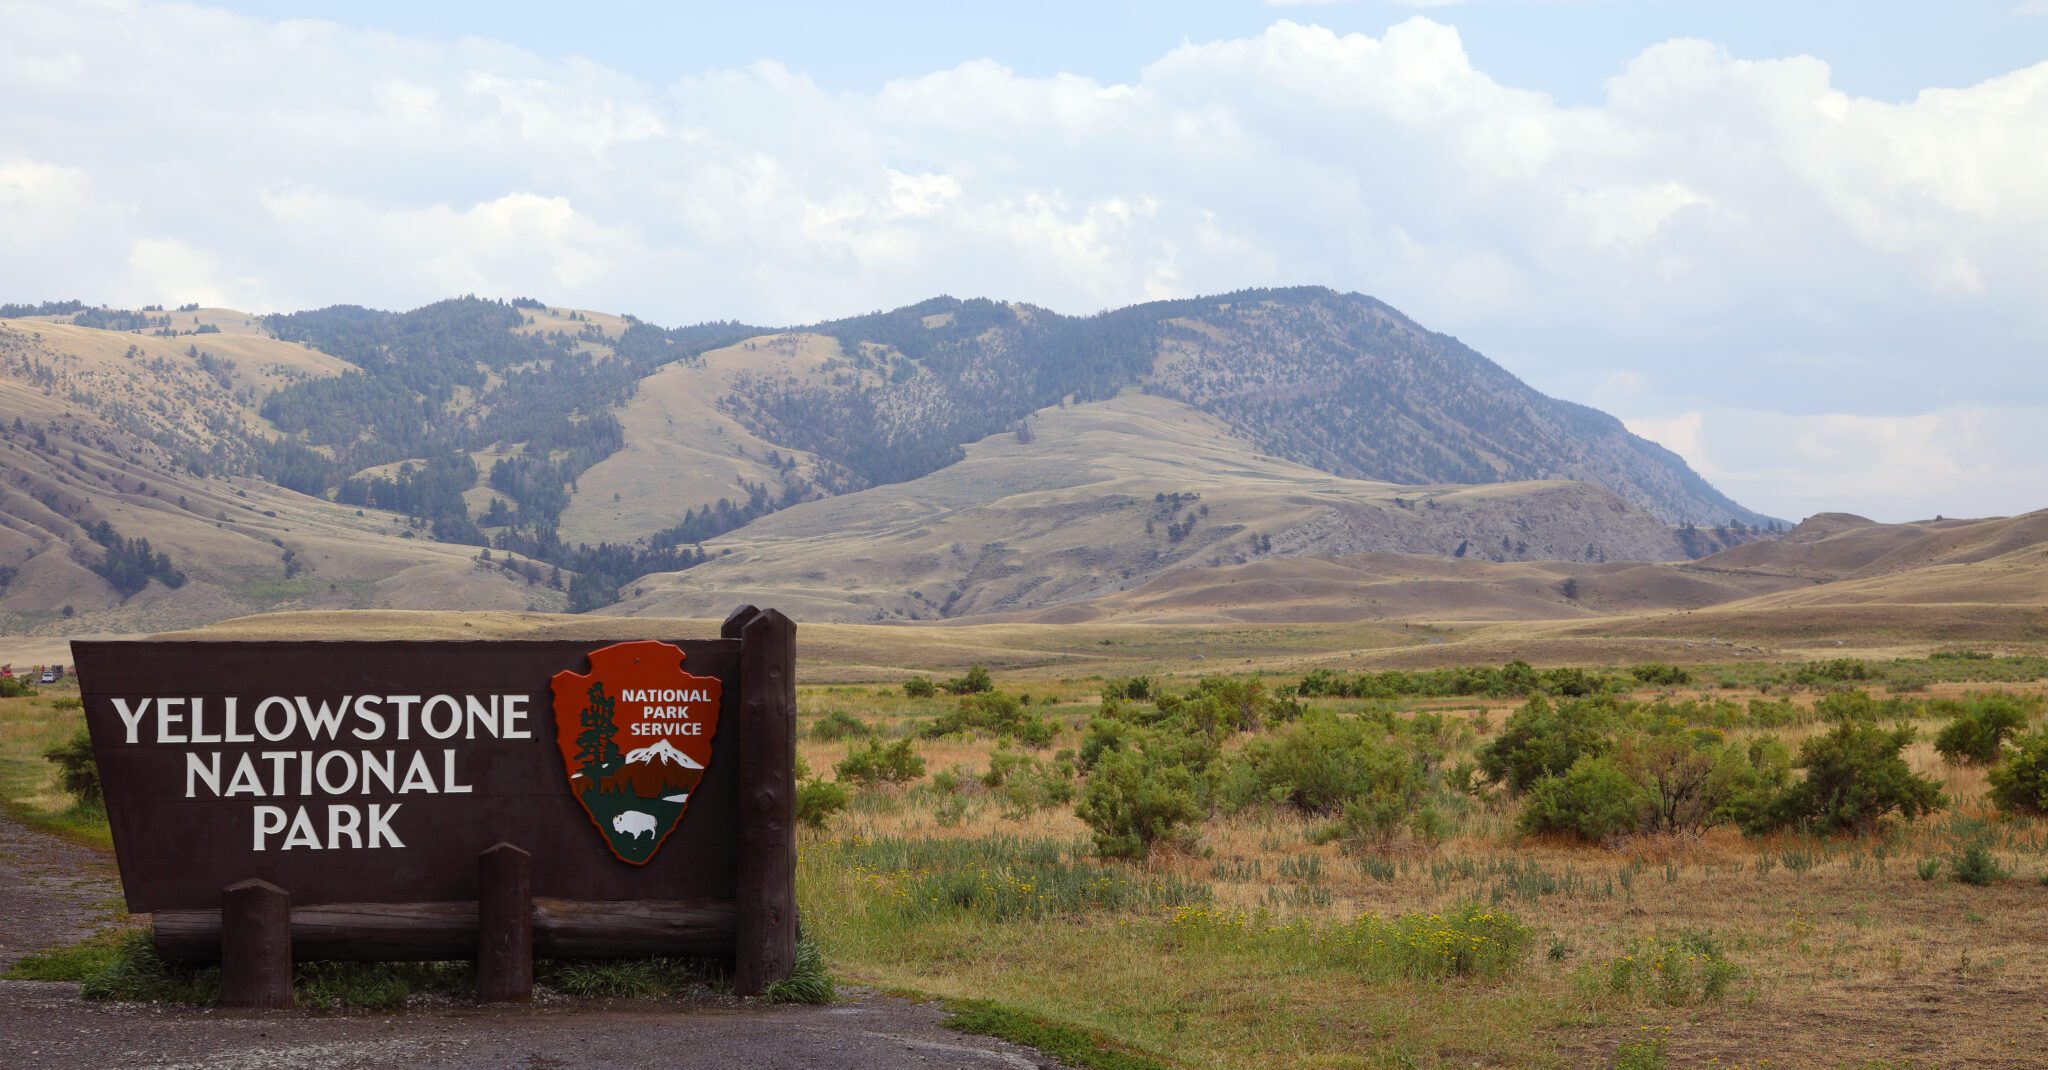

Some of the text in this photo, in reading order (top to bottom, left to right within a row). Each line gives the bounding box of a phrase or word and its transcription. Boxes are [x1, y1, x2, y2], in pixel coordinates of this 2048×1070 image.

[622, 689, 712, 703] NATIONAL
[110, 694, 532, 744] YELLOWSTONE
[643, 705, 689, 719] PARK
[630, 722, 702, 736] SERVICE
[185, 748, 473, 798] NATIONAL
[252, 803, 407, 851] PARK
